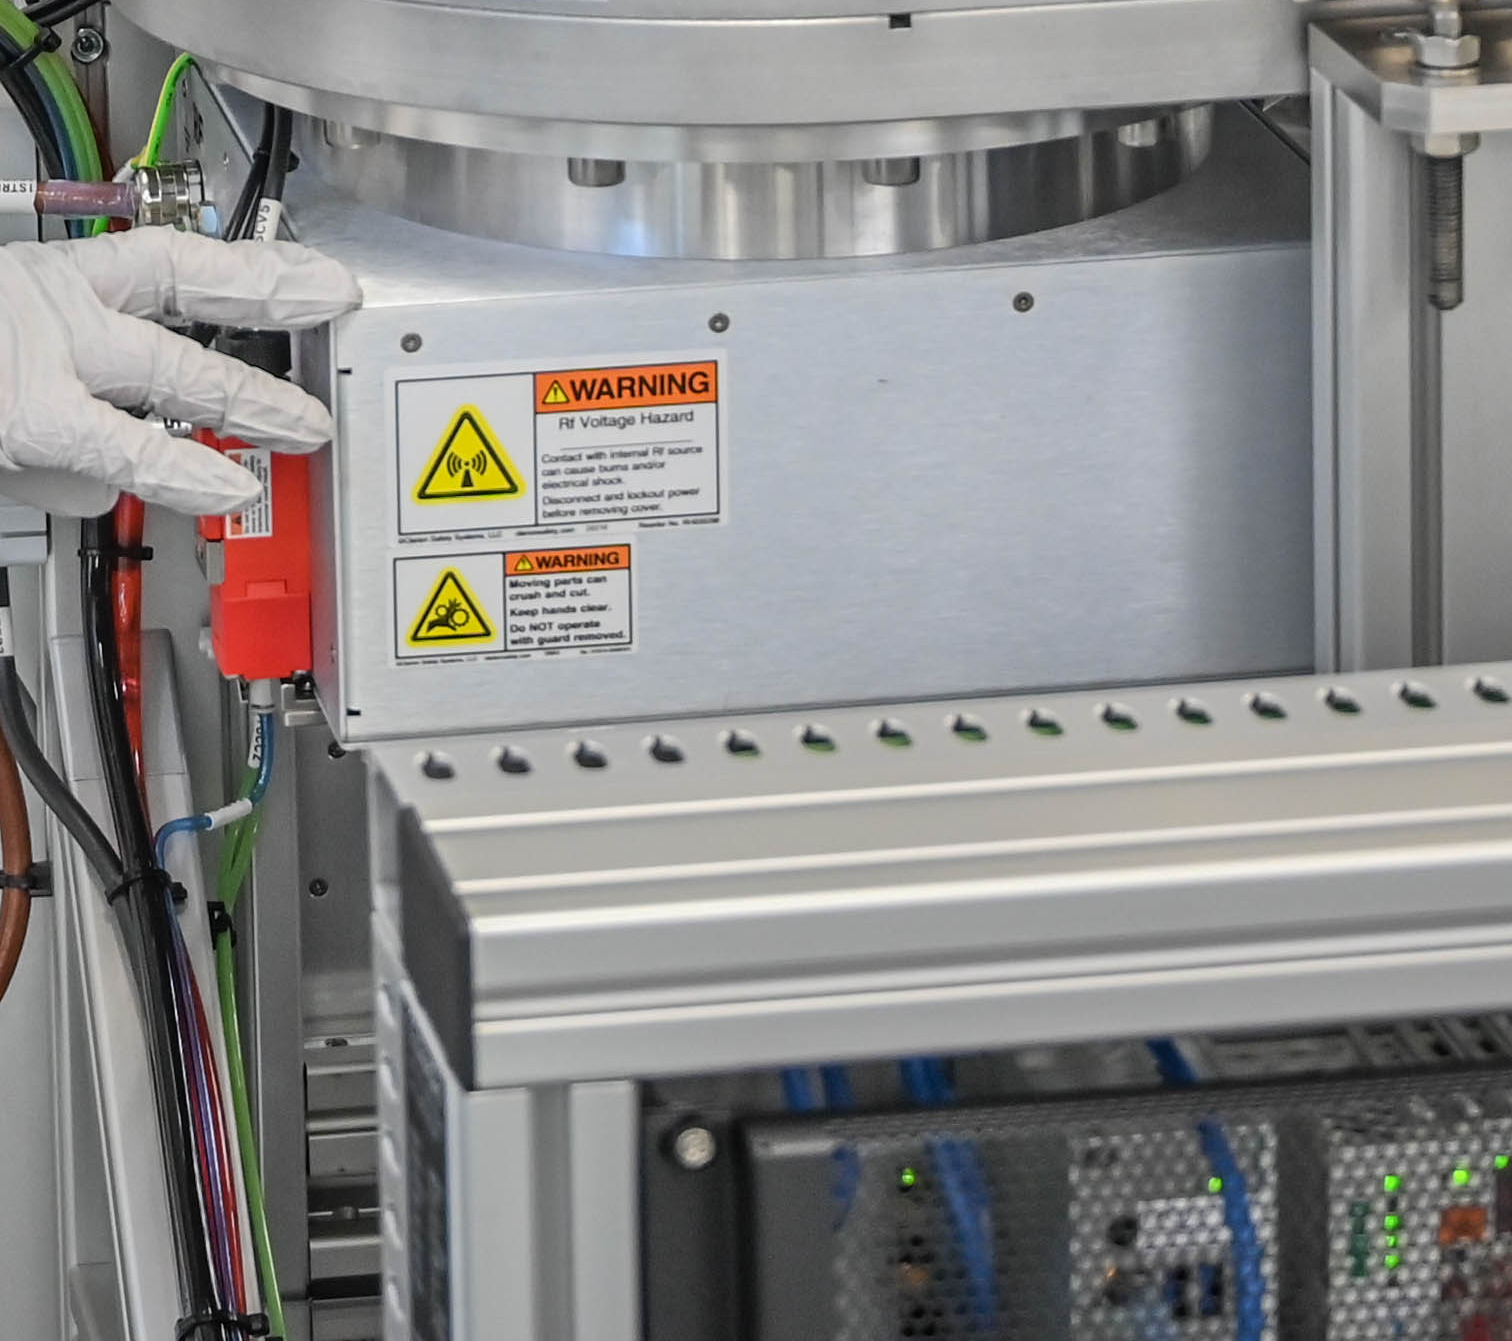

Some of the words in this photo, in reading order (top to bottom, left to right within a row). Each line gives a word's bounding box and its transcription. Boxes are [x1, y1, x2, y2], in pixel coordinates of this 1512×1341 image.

[570, 371, 711, 401] WARNING
[559, 417, 576, 430] Rf
[580, 414, 635, 429] Voltage
[641, 410, 694, 425] Hazard
[541, 453, 583, 464] Contact
[586, 451, 607, 461] with
[610, 448, 648, 459] internal
[653, 447, 665, 456] Rf
[668, 446, 703, 456] source
[542, 468, 561, 476] can
[564, 465, 595, 475] cause
[599, 463, 629, 473] burns
[632, 461, 666, 471] and/or
[542, 479, 588, 490] electrical
[592, 476, 625, 486] shock.
[543, 493, 601, 506] Disconnect
[604, 491, 624, 501] and
[627, 488, 665, 500] lockout
[668, 488, 700, 498] power
[543, 507, 576, 518] before
[579, 504, 628, 516] removing
[631, 503, 662, 512] cover.
[536, 552, 620, 569] WARNING
[509, 577, 551, 589] Moving
[554, 575, 583, 587] parts
[587, 574, 607, 584] can
[509, 589, 542, 602] crush
[545, 588, 566, 599] and
[570, 588, 591, 598] cut.
[510, 606, 539, 619] Keep
[542, 604, 577, 615] hands
[581, 602, 612, 613] clear.
[510, 622, 525, 634] Do
[529, 621, 553, 632] NOT
[558, 619, 600, 631] operate
[510, 635, 534, 646] with
[537, 633, 570, 646] guard
[574, 630, 626, 642] removed.
